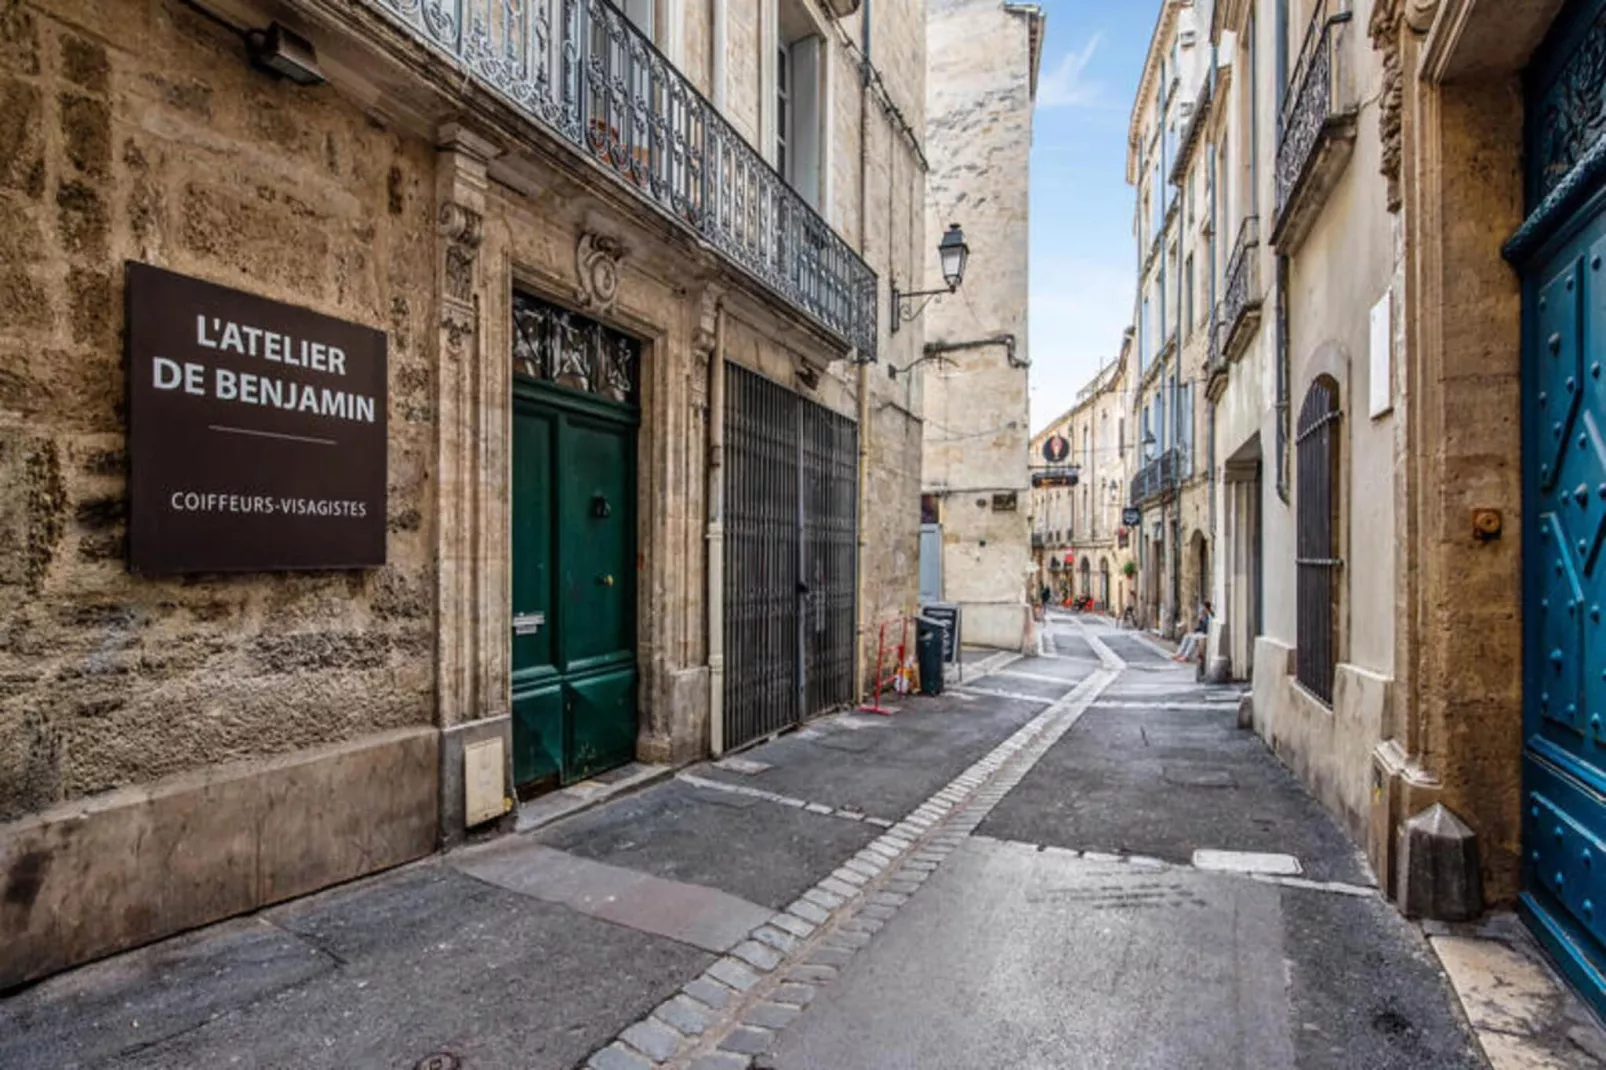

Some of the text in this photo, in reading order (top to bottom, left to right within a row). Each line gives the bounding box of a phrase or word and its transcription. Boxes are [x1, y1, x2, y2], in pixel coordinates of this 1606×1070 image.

[196, 314, 347, 376] L'ATELIER
[152, 355, 375, 423] DE BENJAMIN
[171, 490, 368, 518] COIFFEURS-VISAGISTES
